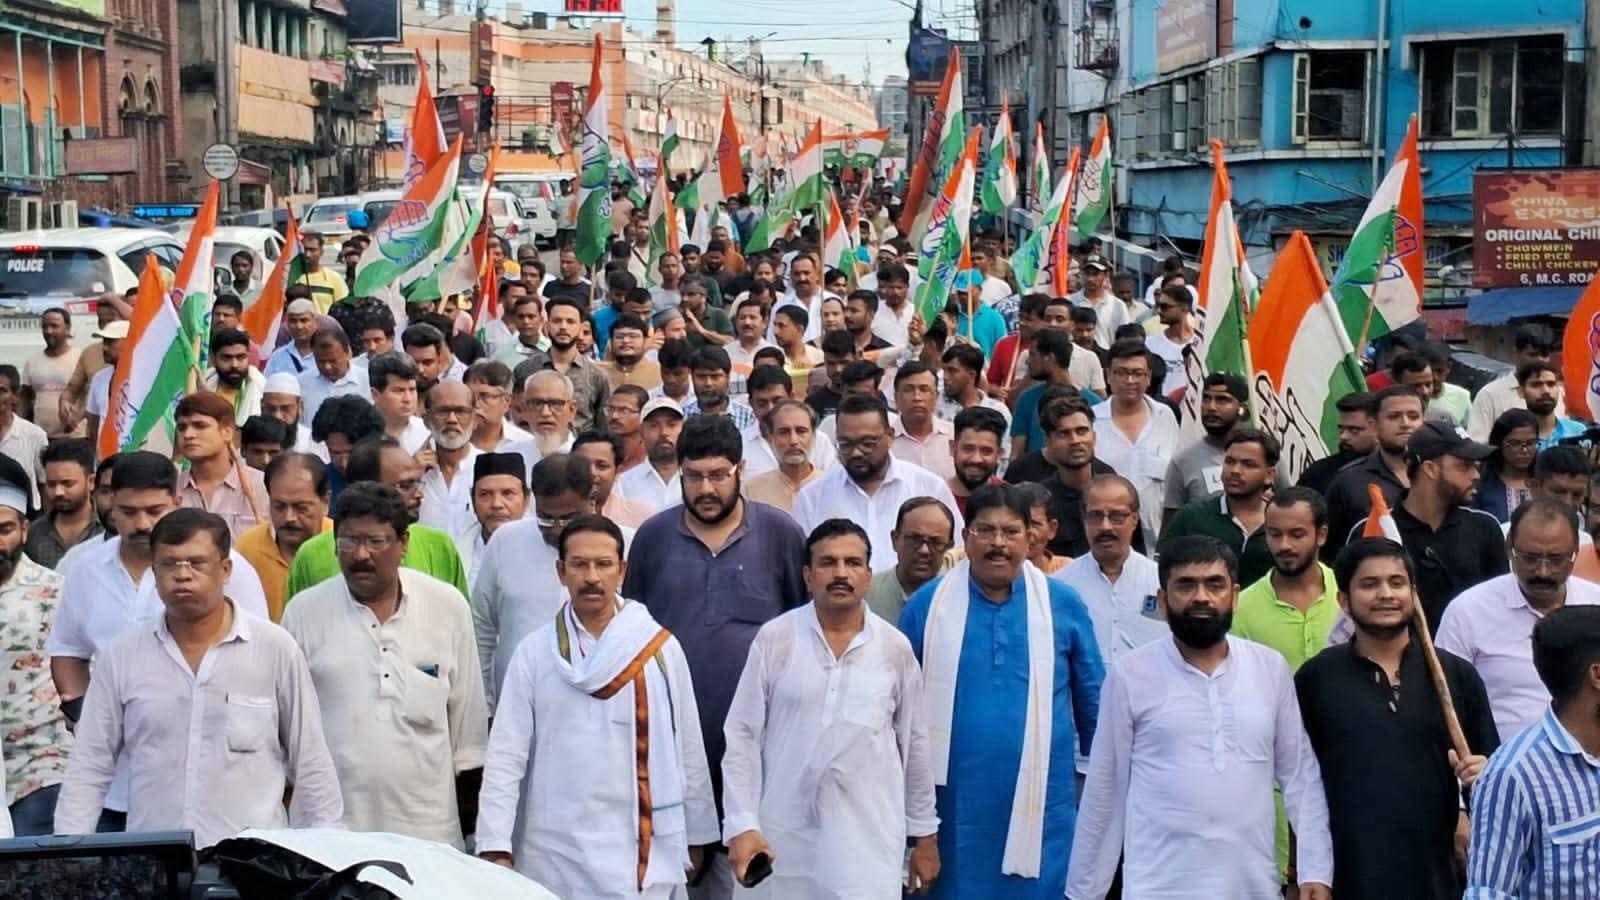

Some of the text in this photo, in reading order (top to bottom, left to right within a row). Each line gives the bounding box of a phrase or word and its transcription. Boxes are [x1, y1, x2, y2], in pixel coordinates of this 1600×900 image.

[1485, 229, 1563, 242] ORIGINAL
[1505, 244, 1573, 252] CHOWMEIN
[1505, 252, 1571, 261] FRIED RICE
[7, 259, 45, 273] POLICE
[1505, 260, 1598, 270] CHILLI CHICKEN
[1520, 273, 1533, 285] 6,
[1568, 272, 1596, 283] ROA
